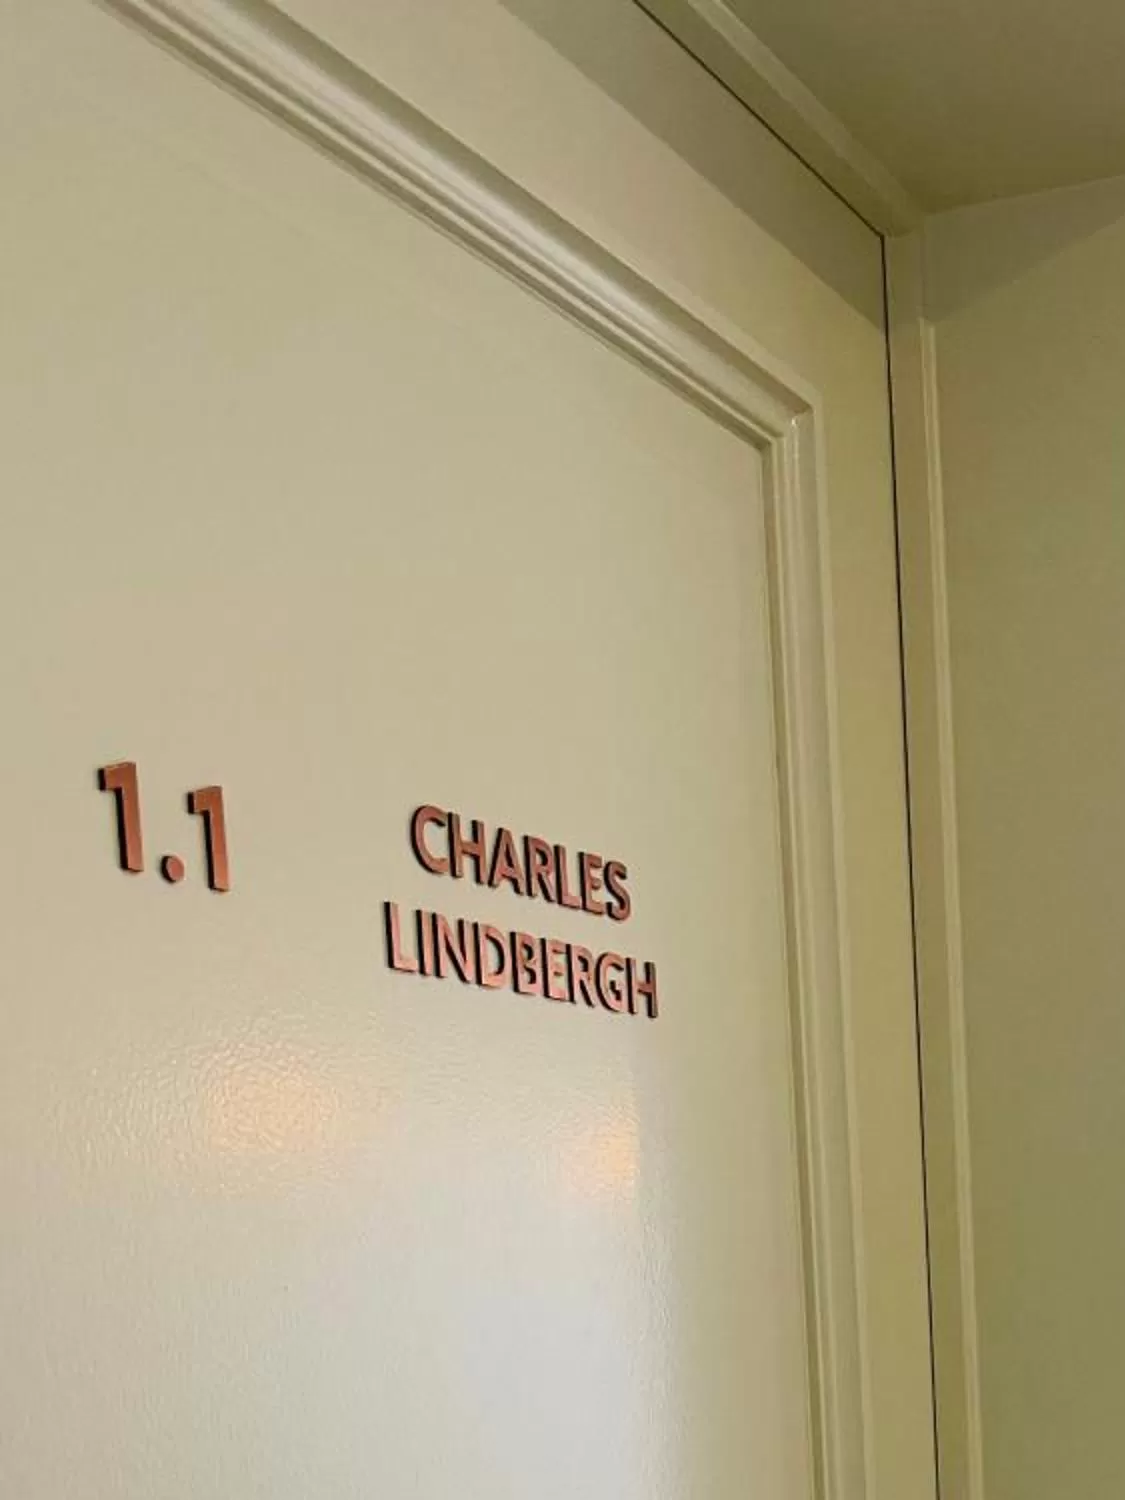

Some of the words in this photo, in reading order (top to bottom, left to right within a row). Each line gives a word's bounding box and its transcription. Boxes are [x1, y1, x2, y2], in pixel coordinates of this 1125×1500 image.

[97, 761, 229, 893] 1.1
[410, 804, 632, 922] CHARLES
[383, 901, 659, 1019] LINDBERGH
